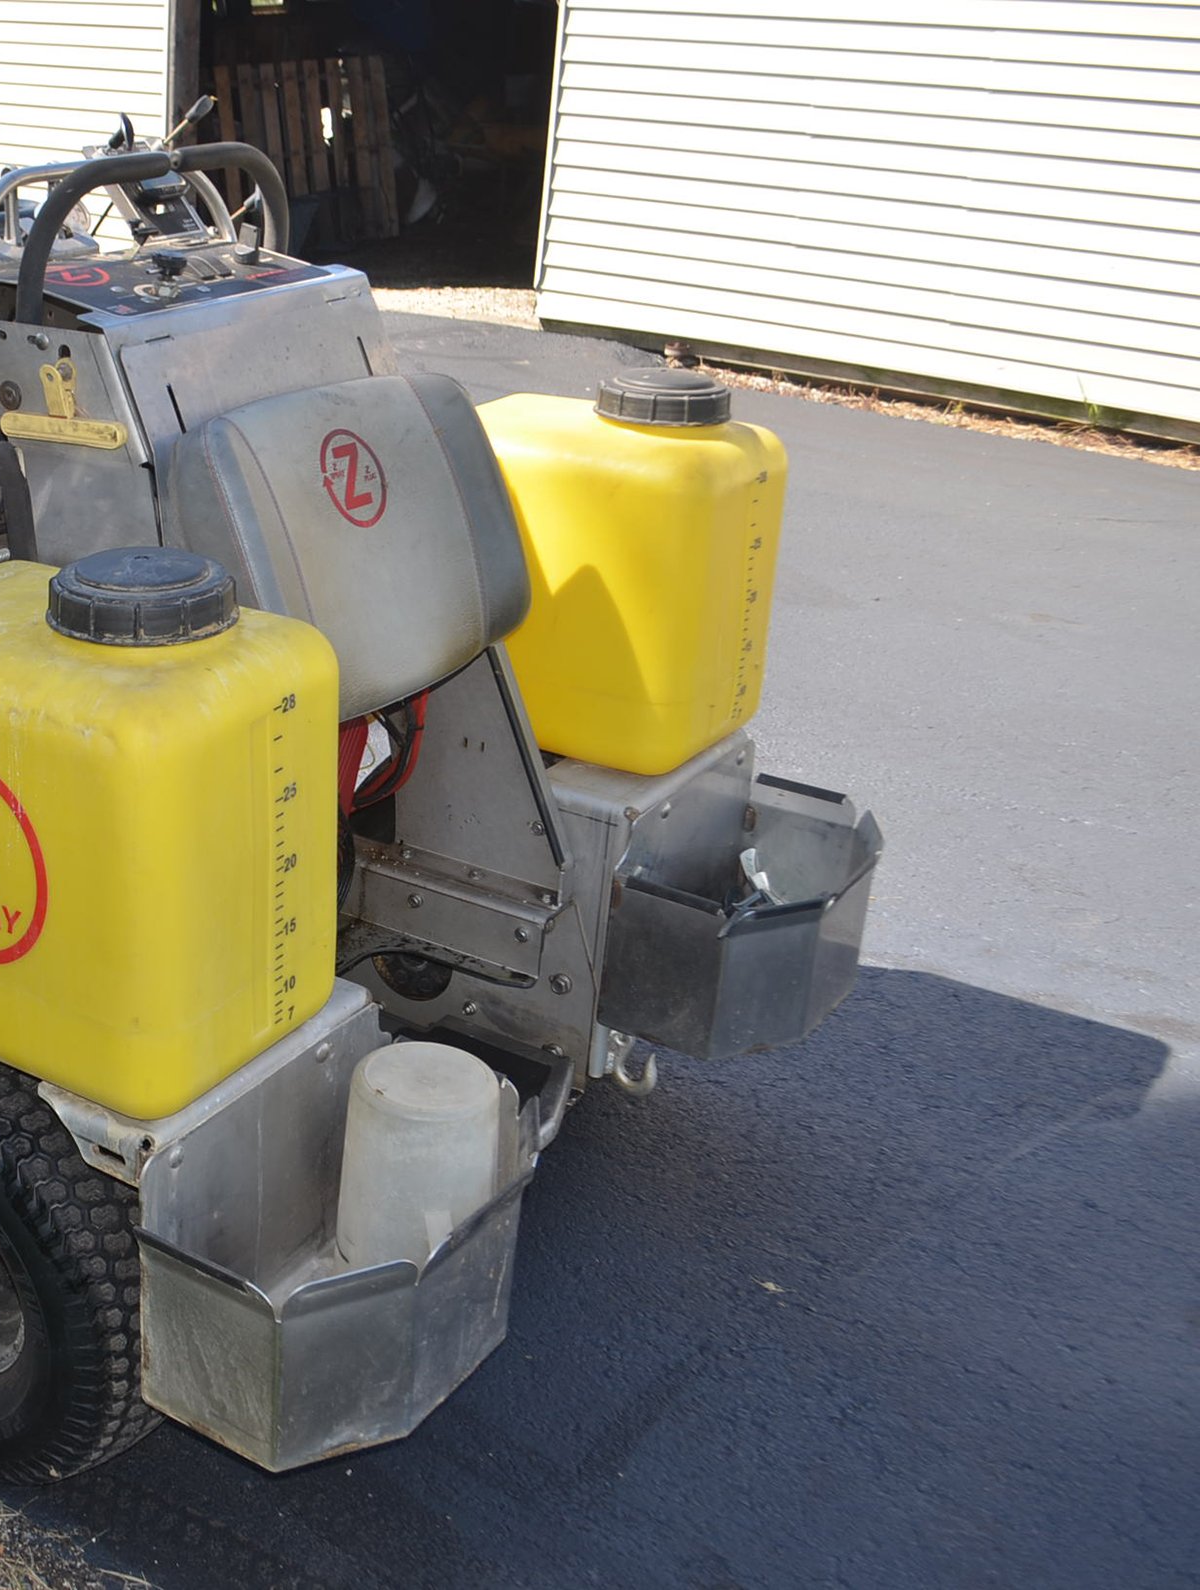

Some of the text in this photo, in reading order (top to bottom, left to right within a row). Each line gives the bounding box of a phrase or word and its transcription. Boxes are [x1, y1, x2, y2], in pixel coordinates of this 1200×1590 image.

[331, 442, 373, 511] Z
[282, 693, 296, 713] 28
[283, 782, 297, 802] 25
[284, 853, 297, 873] 20
[283, 917, 297, 935] 15
[283, 975, 296, 993] 10
[288, 1005, 295, 1020] 7
